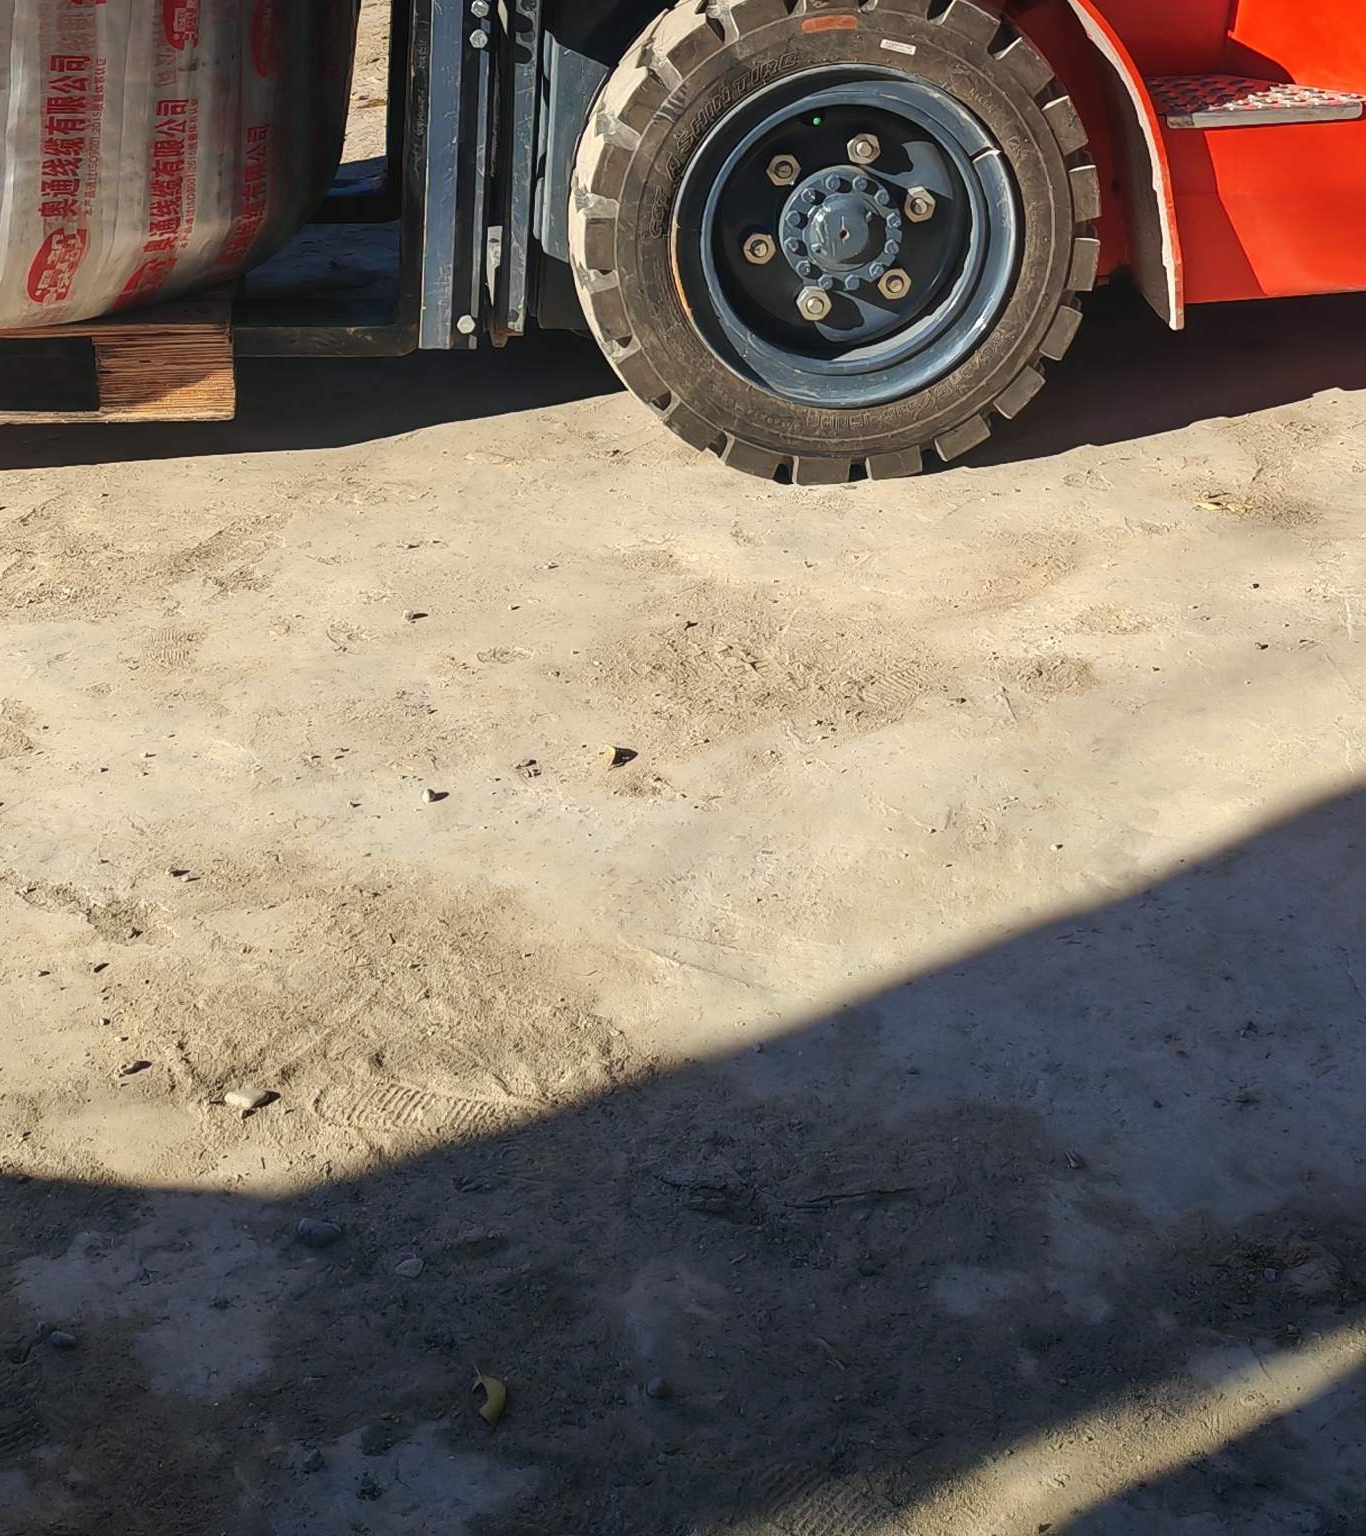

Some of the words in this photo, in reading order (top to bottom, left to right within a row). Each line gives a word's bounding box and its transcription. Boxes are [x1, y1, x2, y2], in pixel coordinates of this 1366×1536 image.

[38, 54, 91, 218] 奥通线缆有限公司
[143, 99, 189, 254] 奥通线缆有限公司
